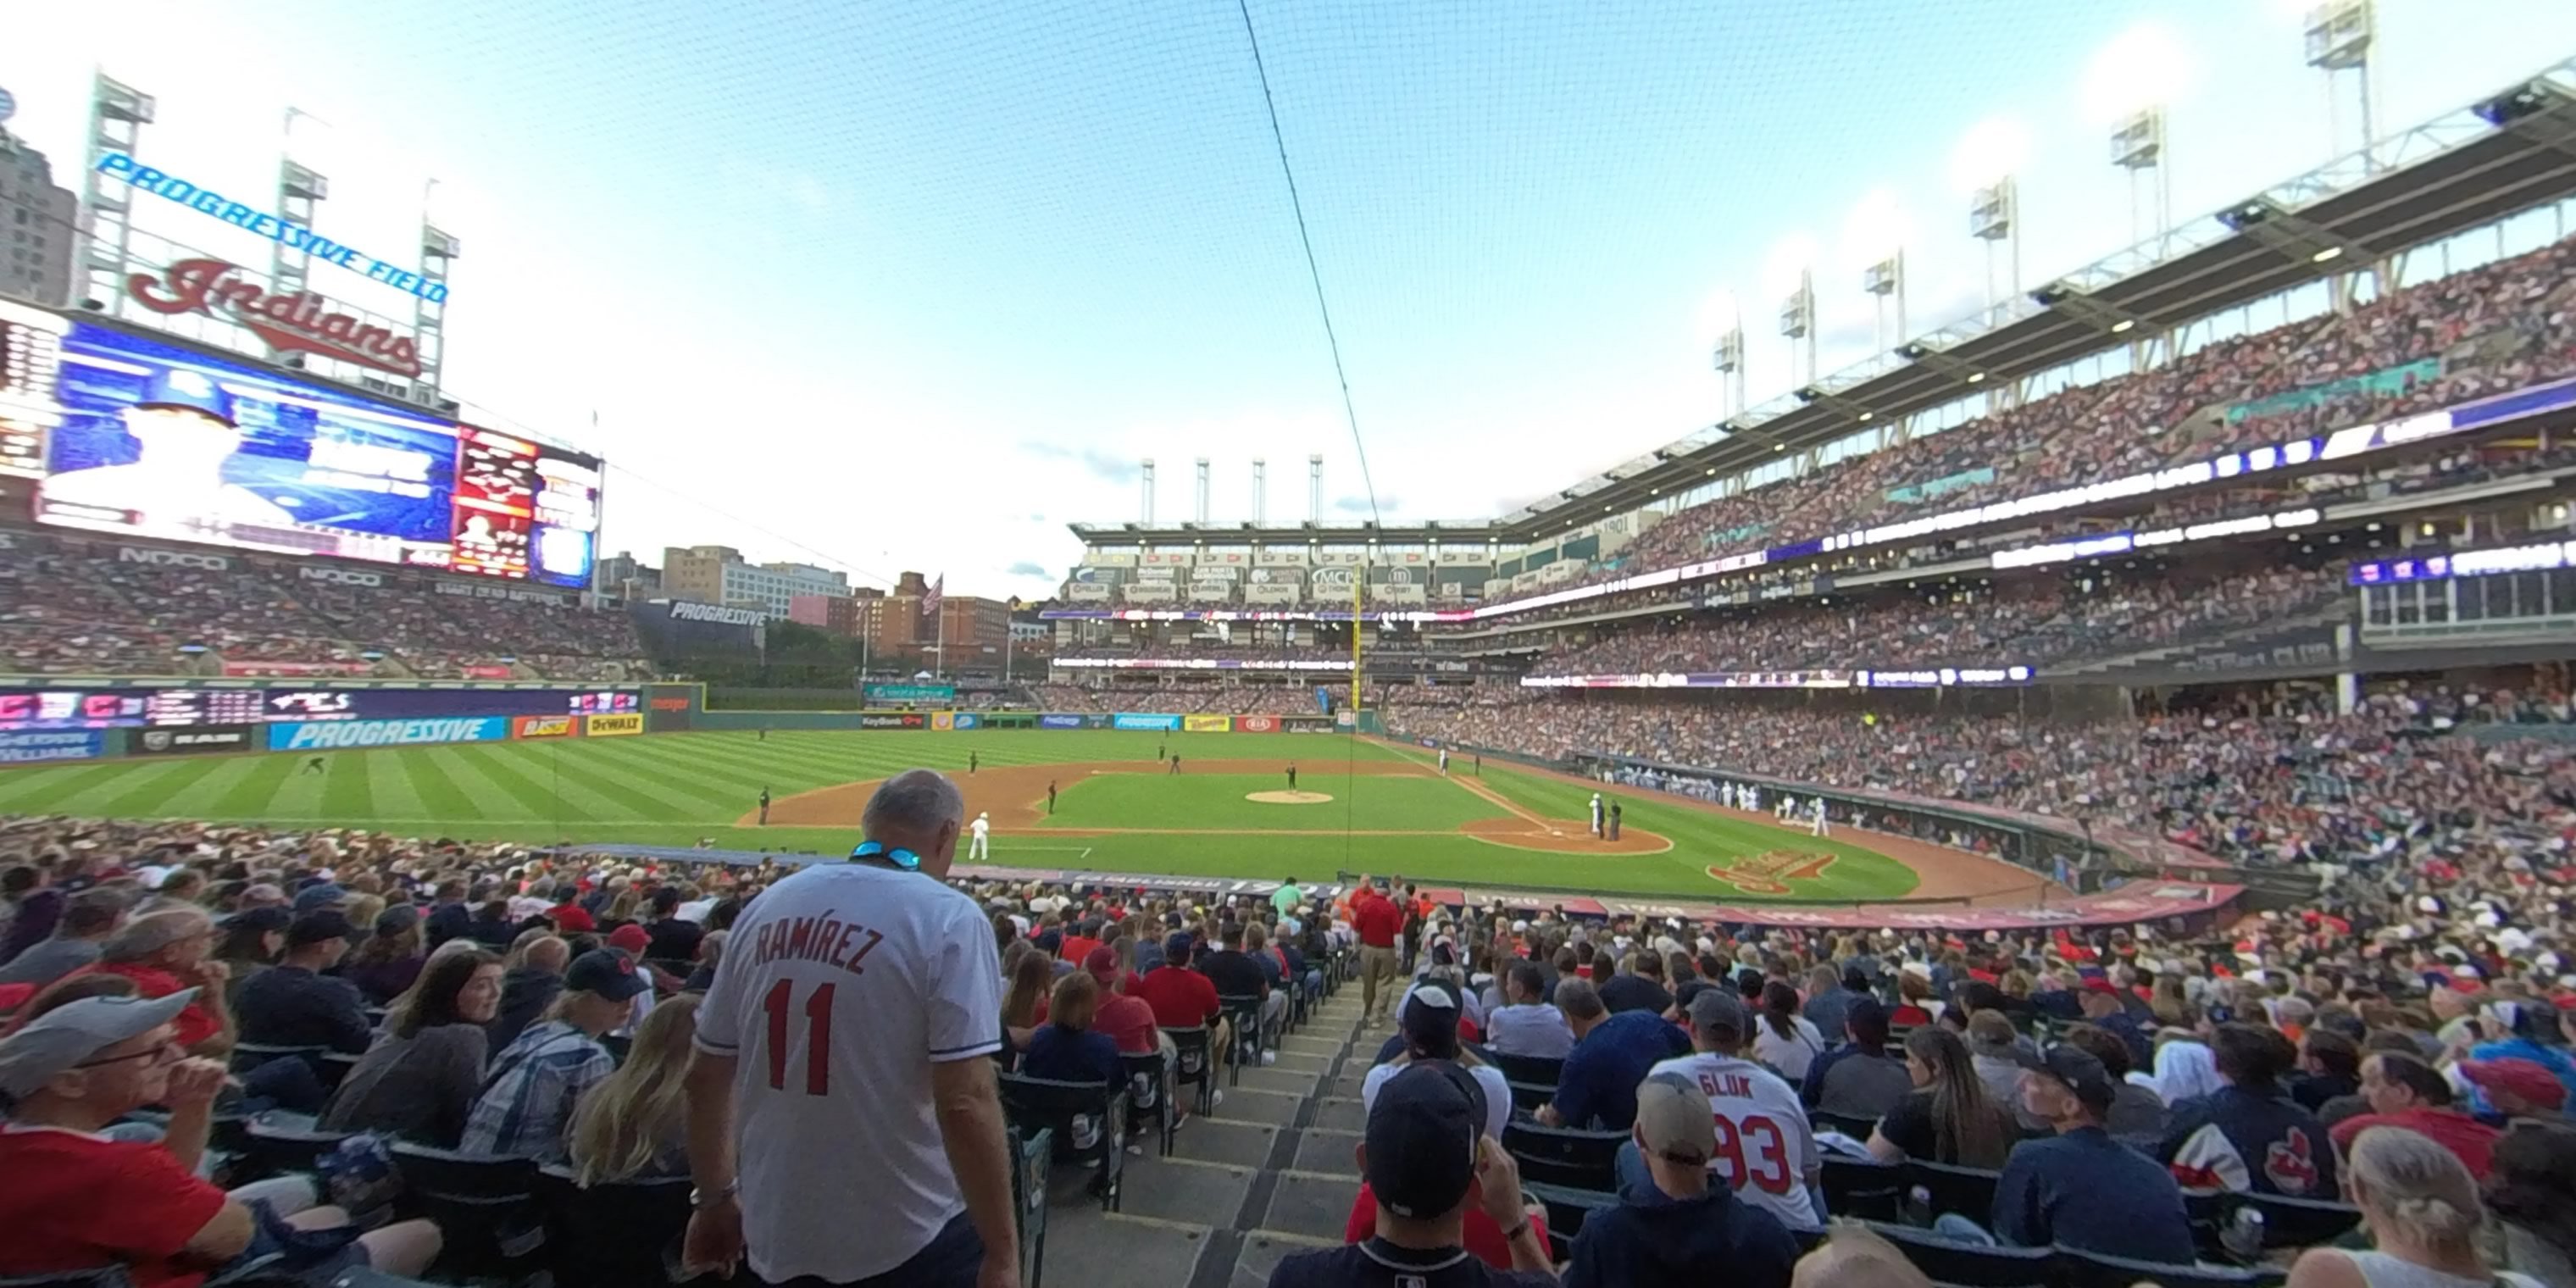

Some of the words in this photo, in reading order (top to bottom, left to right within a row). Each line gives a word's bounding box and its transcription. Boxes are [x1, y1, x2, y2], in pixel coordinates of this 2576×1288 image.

[95, 152, 362, 270] PROGRESSIVE
[365, 257, 449, 304] FIELD
[127, 258, 422, 378] Indians
[670, 602, 769, 626] PROGRESSIVE
[175, 733, 240, 745] RAM
[288, 719, 488, 749] PROGRESSIVE
[862, 716, 902, 726] KeyBank
[756, 909, 884, 974] RAMÍREZ
[764, 978, 836, 1096] 11
[1712, 1113, 1791, 1196] 93
